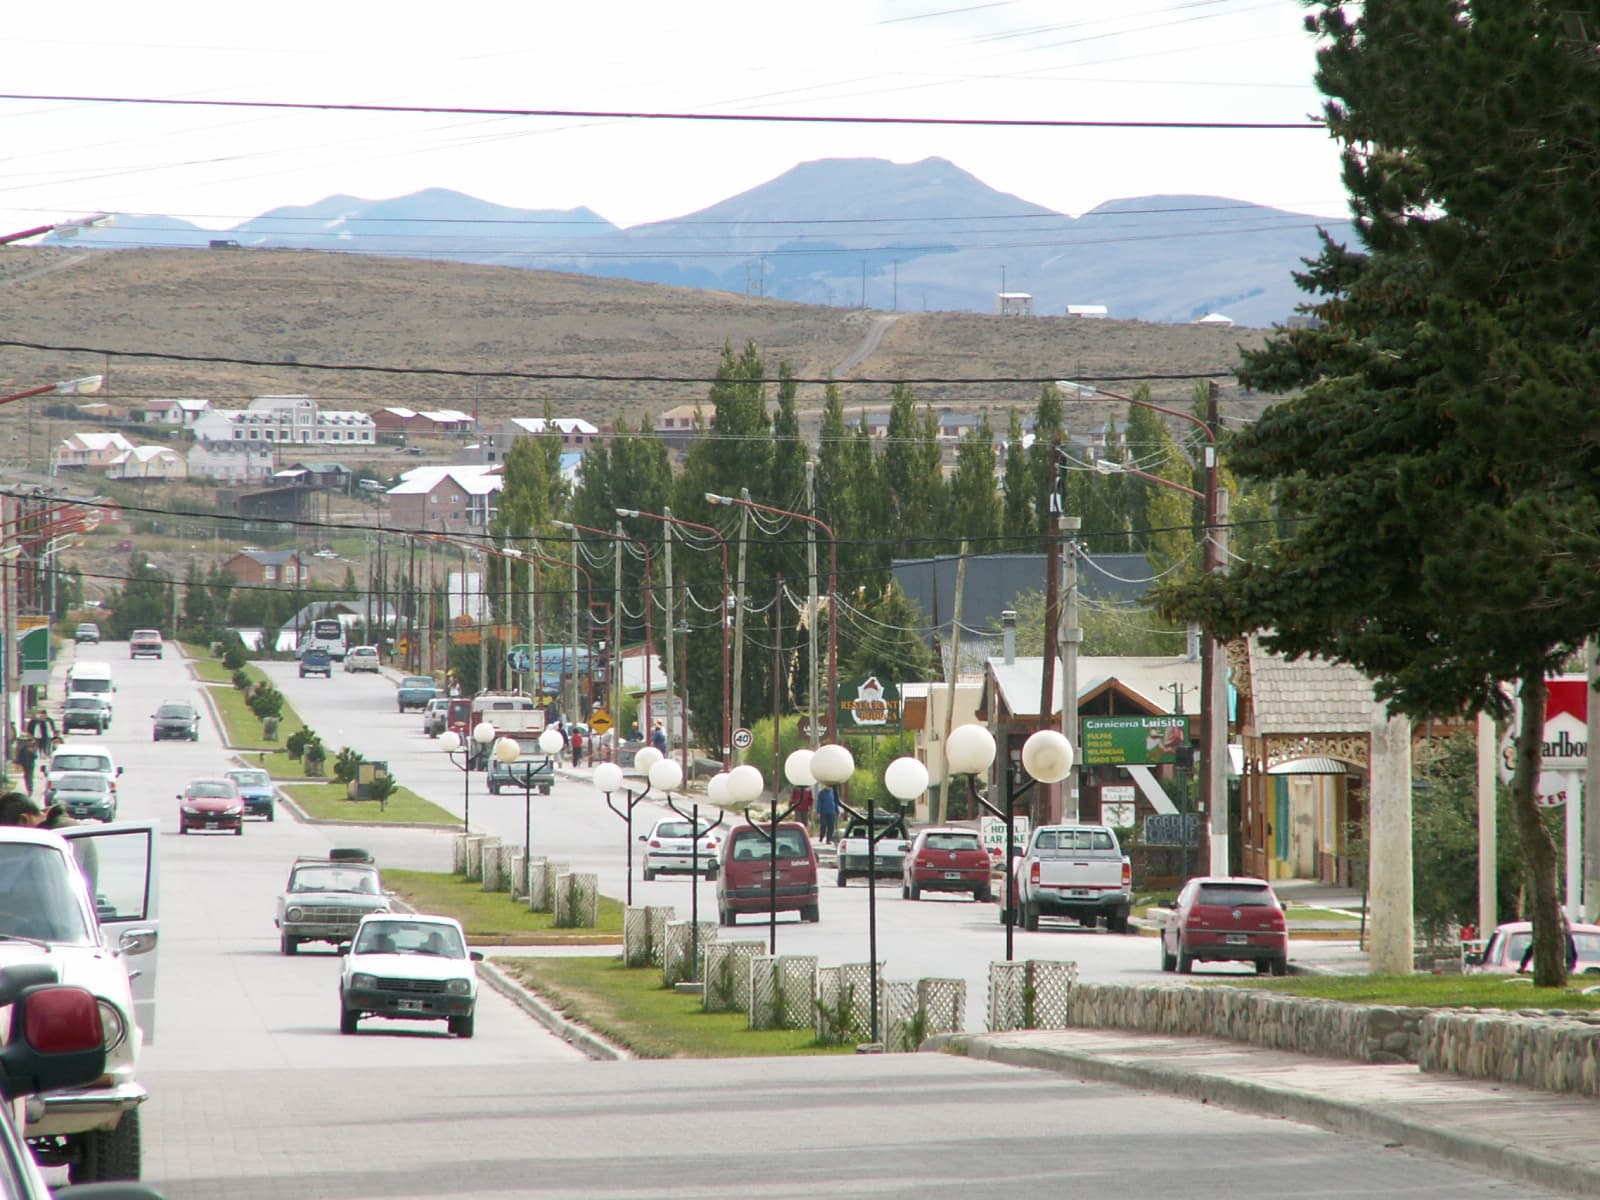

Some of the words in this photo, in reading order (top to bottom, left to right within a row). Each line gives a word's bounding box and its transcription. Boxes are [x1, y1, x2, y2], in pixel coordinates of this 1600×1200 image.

[1142, 717, 1185, 727] Luisito
[736, 734, 749, 743] 40
[991, 825, 1019, 833] HOTL
